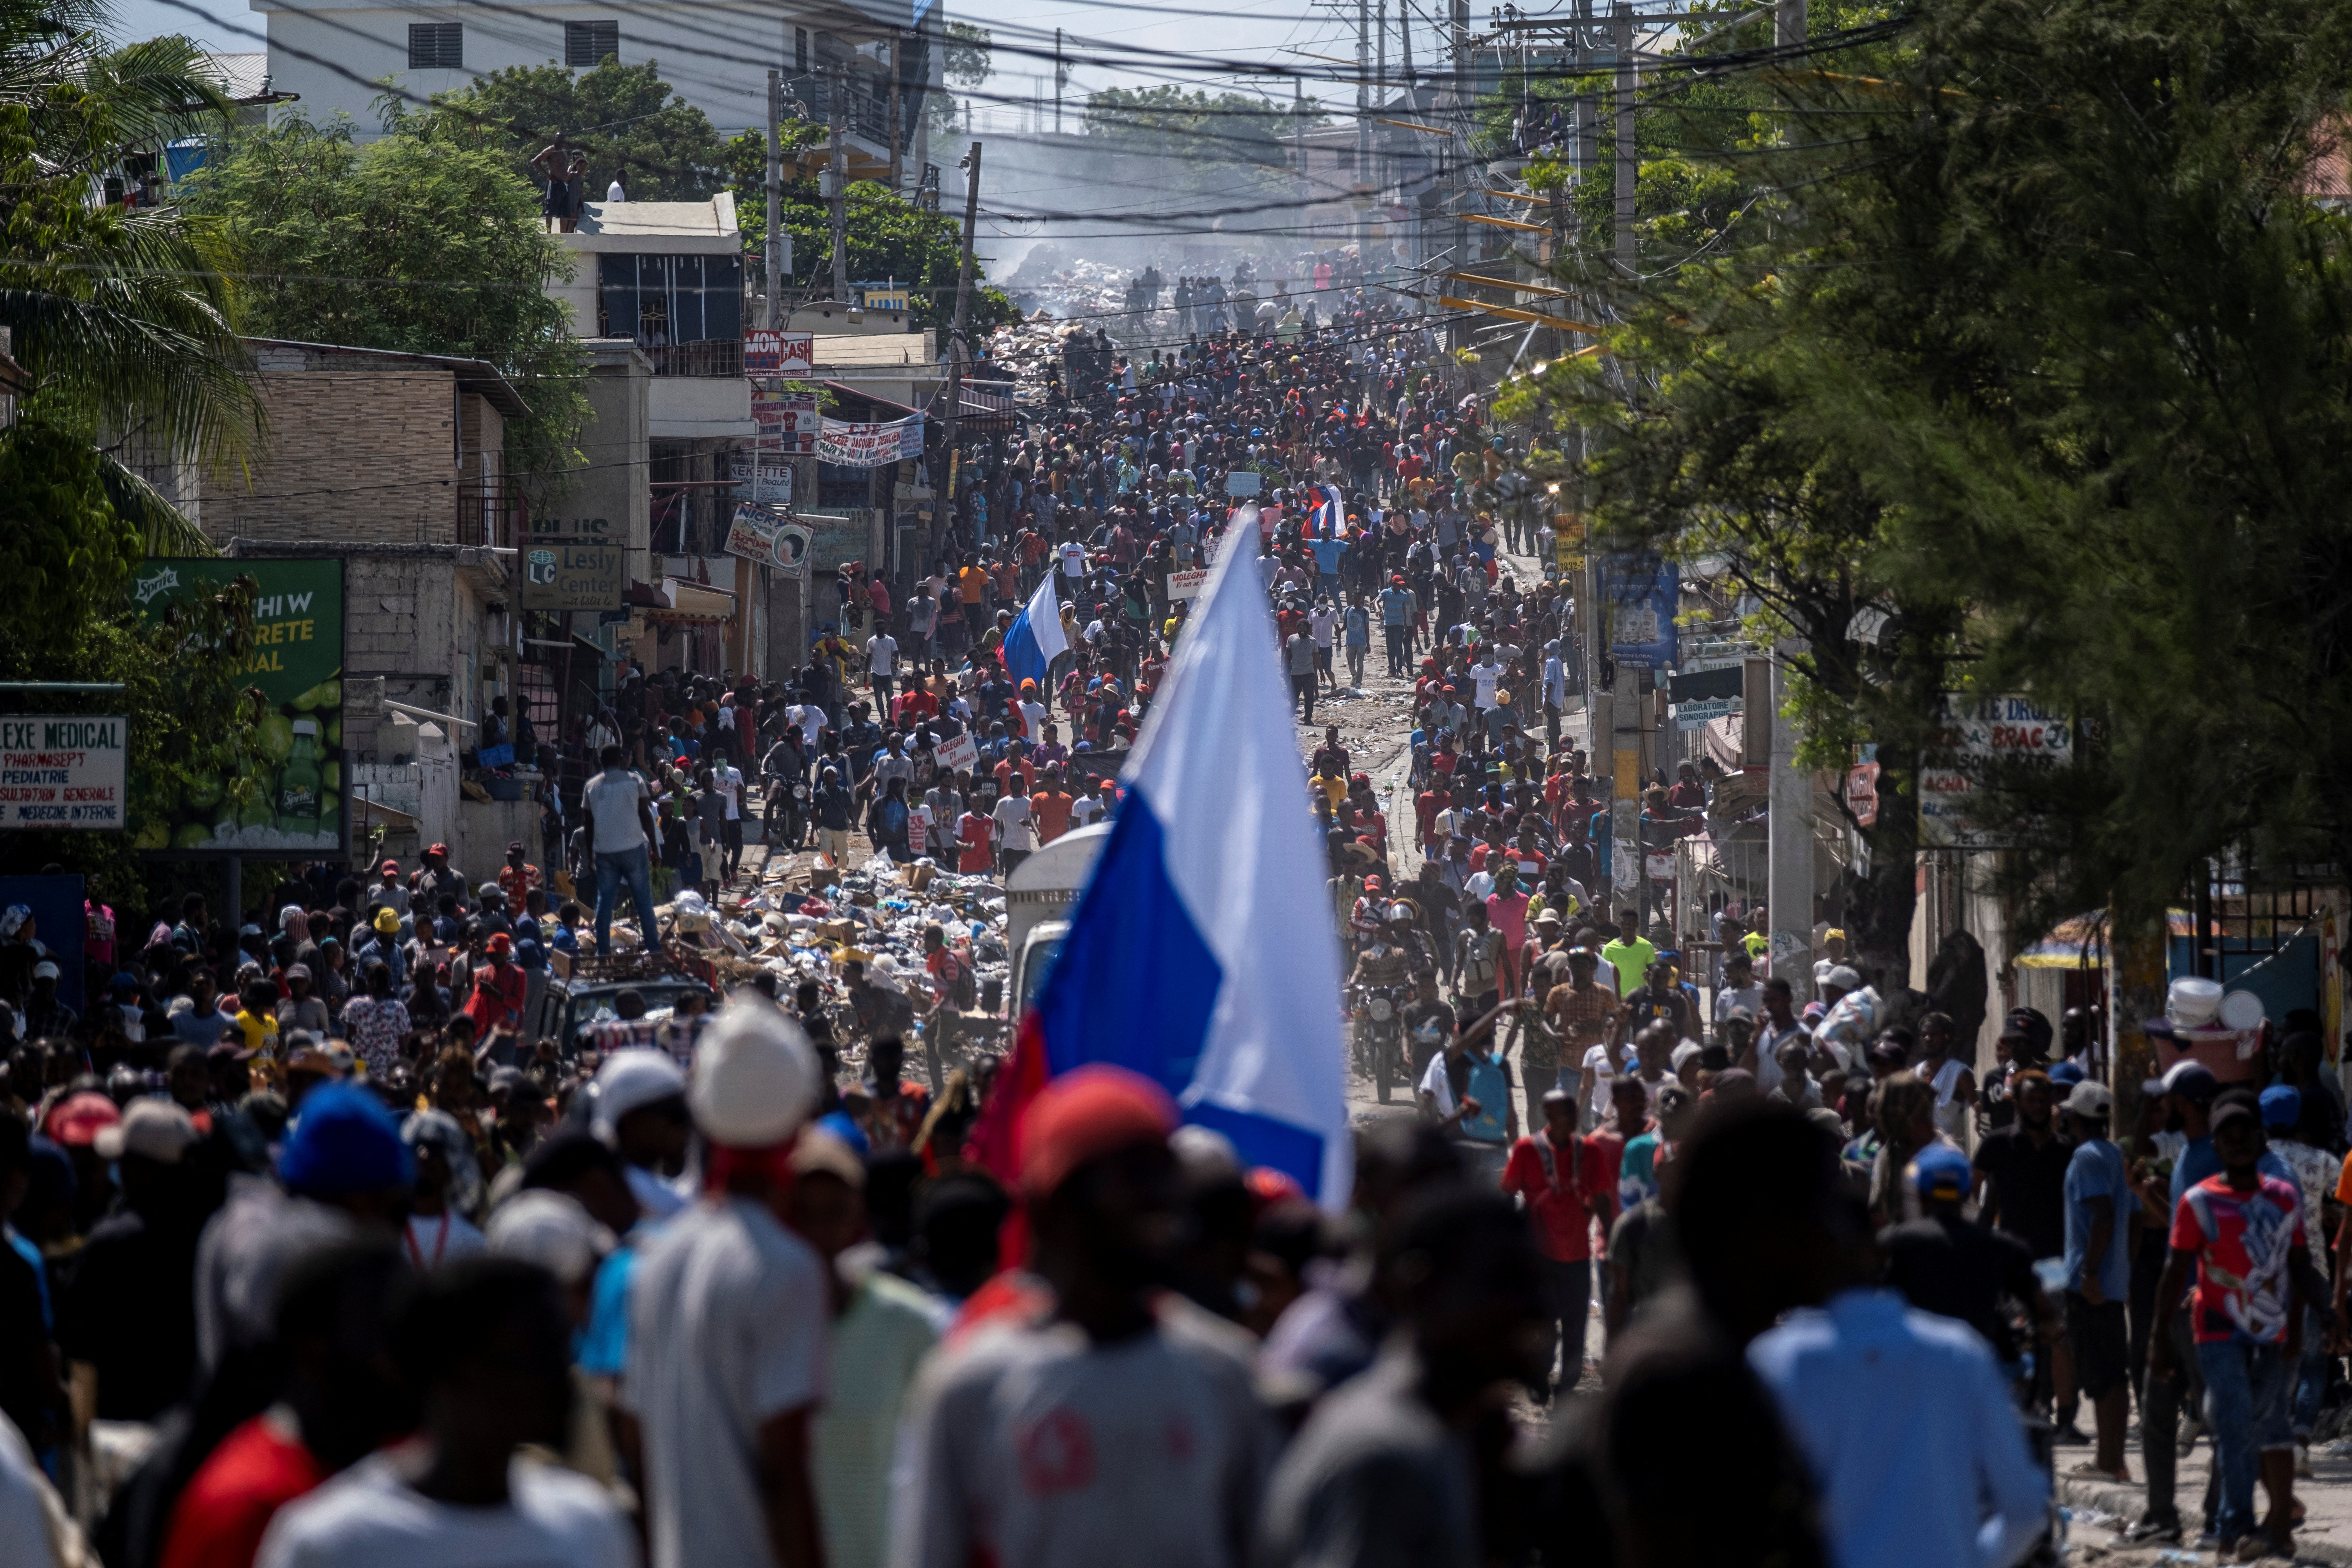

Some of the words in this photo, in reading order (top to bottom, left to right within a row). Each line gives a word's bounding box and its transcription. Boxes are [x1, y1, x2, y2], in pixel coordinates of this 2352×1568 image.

[745, 332, 779, 353] MON
[745, 355, 780, 368] NAT
[781, 337, 812, 369] CASH
[823, 432, 849, 446] COLLEGE
[851, 437, 876, 449] JACQUES
[847, 449, 863, 459] DORA
[738, 506, 788, 527] NICKY
[731, 528, 773, 550] Barber
[732, 541, 765, 560] Shop
[564, 547, 616, 575] Lesly
[530, 563, 555, 584] LC
[559, 575, 614, 593] Center
[1467, 577, 1481, 593] 76
[1678, 701, 1729, 712] LABORATOIRE
[1678, 710, 1729, 721] SONOGRAPHIE
[0, 723, 36, 750] EXE
[45, 723, 121, 749] MEDICAL
[937, 733, 967, 756] MOLEGHAF
[4, 752, 86, 767] PHARMASEPT
[949, 750, 956, 760] DI
[951, 750, 975, 768] SOSYALIS
[2, 770, 69, 784] PEDIATRIE
[63, 786, 115, 801] GENERALE
[17, 805, 68, 820] MEDECINE
[71, 805, 117, 820] INTERNE
